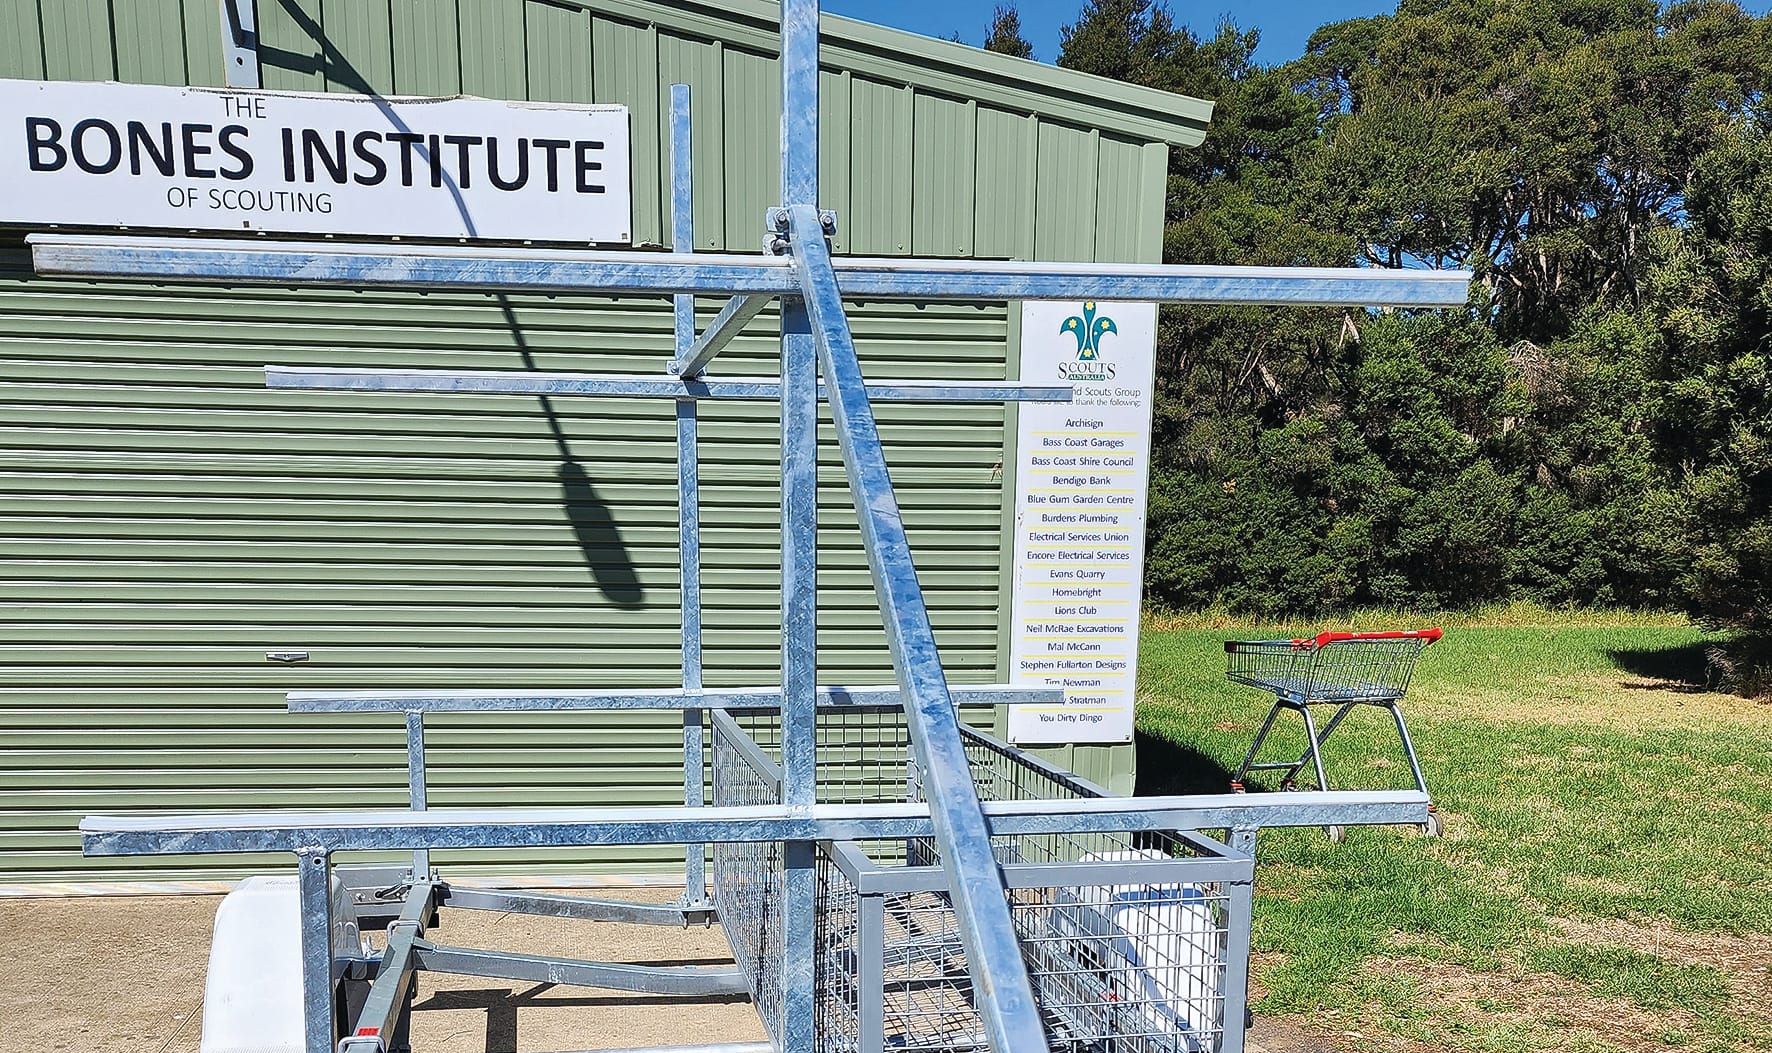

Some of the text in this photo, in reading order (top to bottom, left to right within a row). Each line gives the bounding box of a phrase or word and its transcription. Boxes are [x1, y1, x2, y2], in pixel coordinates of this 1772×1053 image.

[220, 95, 267, 119] THE
[24, 116, 607, 195] BONES INSTITUTE
[167, 186, 334, 214] OF SCOUTING
[1058, 362, 1116, 380] SCOUTS
[1085, 387, 1112, 396] Scouts
[1114, 388, 1141, 397] Group
[1065, 418, 1104, 429] Archisign
[1042, 438, 1124, 448] Bass Coast Garages
[1031, 457, 1134, 466] Bass Coast Shire Council
[1052, 476, 1111, 486] Bendigo Bank
[1027, 495, 1134, 504] Blue Gum Garden Centre
[1042, 514, 1118, 524] Burdens Plumbing
[1029, 532, 1129, 541] Electrical Services Union
[1027, 551, 1129, 560] Encore Electrical Services
[1050, 569, 1105, 580] Evans Quarry
[1052, 588, 1102, 598] Homebright
[1055, 606, 1097, 615] Lions Club
[1026, 624, 1124, 633] Neil McRae Excavations
[1048, 642, 1101, 651] Mal McCann
[1020, 661, 1126, 670] Stephen Fullarton Designs
[1063, 678, 1101, 687] Newman
[1069, 696, 1107, 705] Stratman
[1039, 714, 1103, 723] You Dirty Dingo
